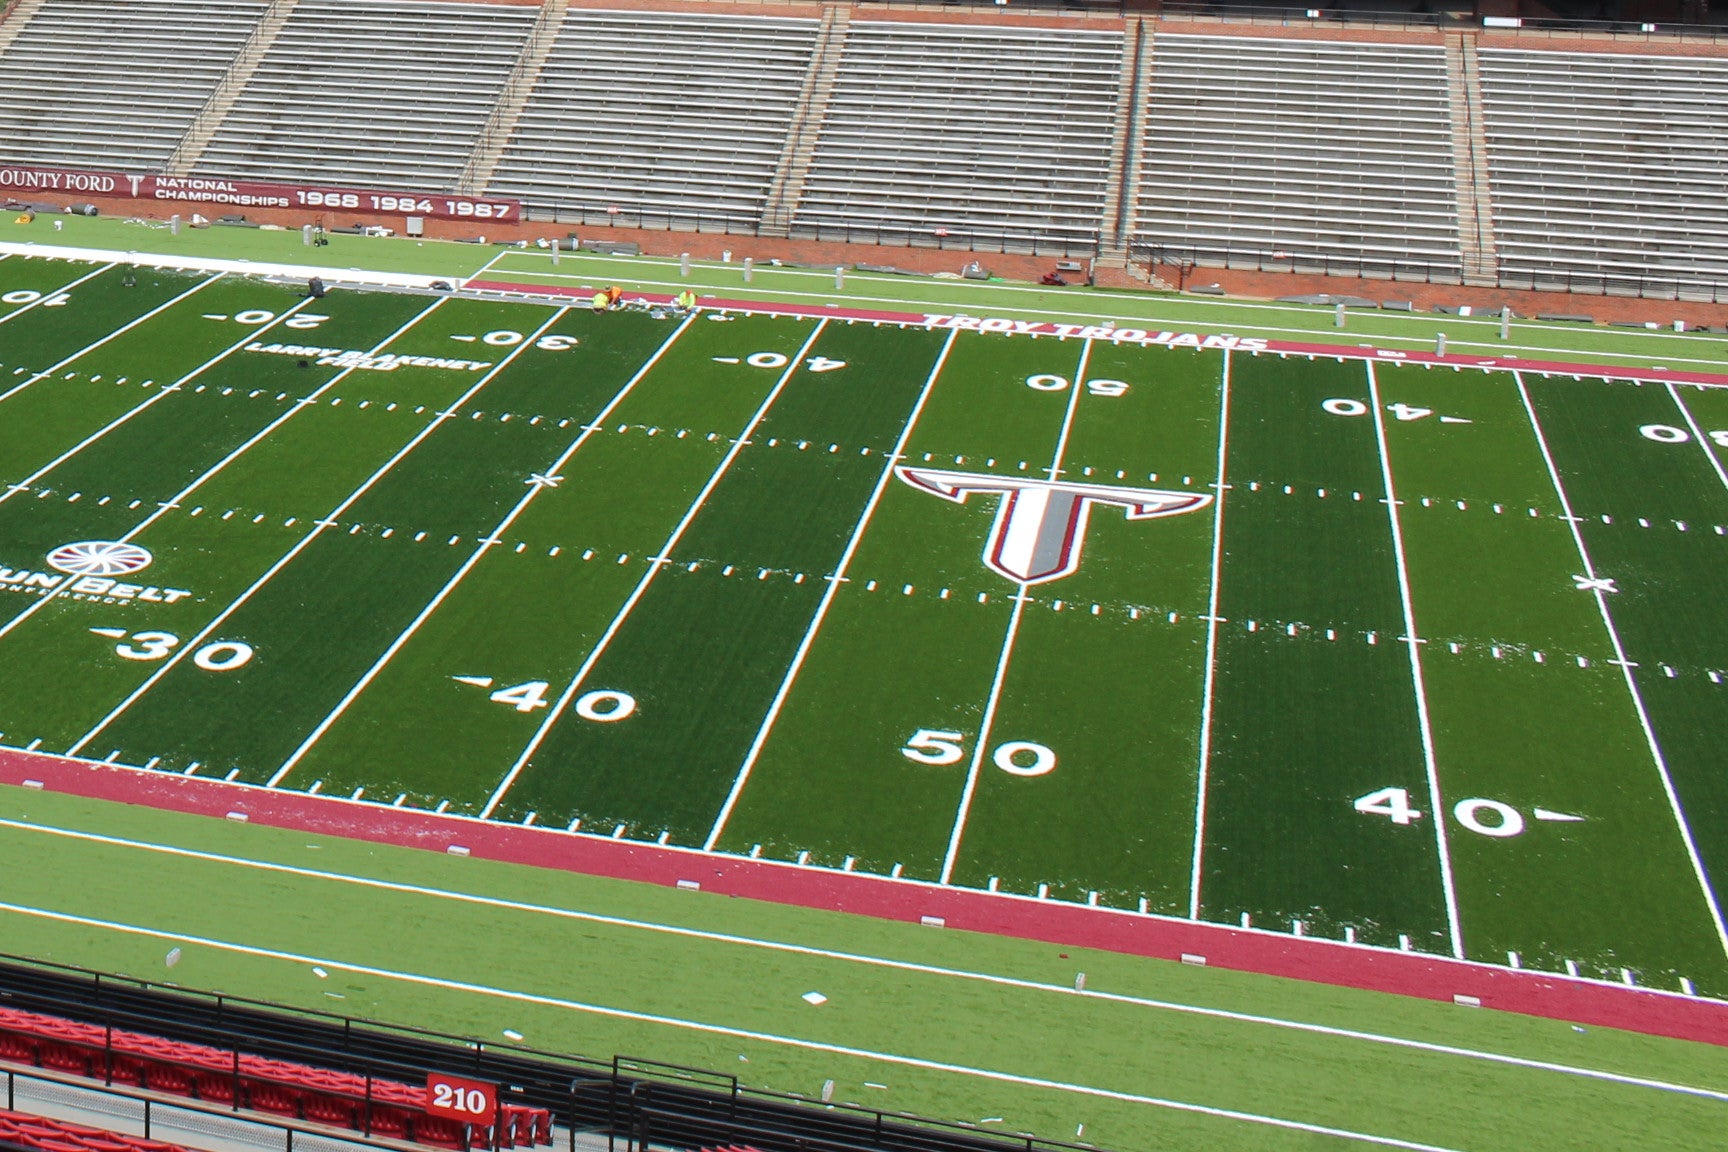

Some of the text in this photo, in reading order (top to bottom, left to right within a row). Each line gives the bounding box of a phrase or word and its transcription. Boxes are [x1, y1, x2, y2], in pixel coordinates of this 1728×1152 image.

[65, 173, 115, 193] FORD
[156, 177, 237, 192] NATIONAL
[155, 189, 289, 208] CHAMPIONSHIPS
[297, 190, 510, 219] 1968 1984 1987
[922, 313, 1268, 349] TROY TROJANS
[244, 342, 492, 371] LARRY BLAKENEY
[315, 356, 400, 371] FIELD
[71, 576, 192, 603] BELT
[433, 1083, 486, 1114] 210
